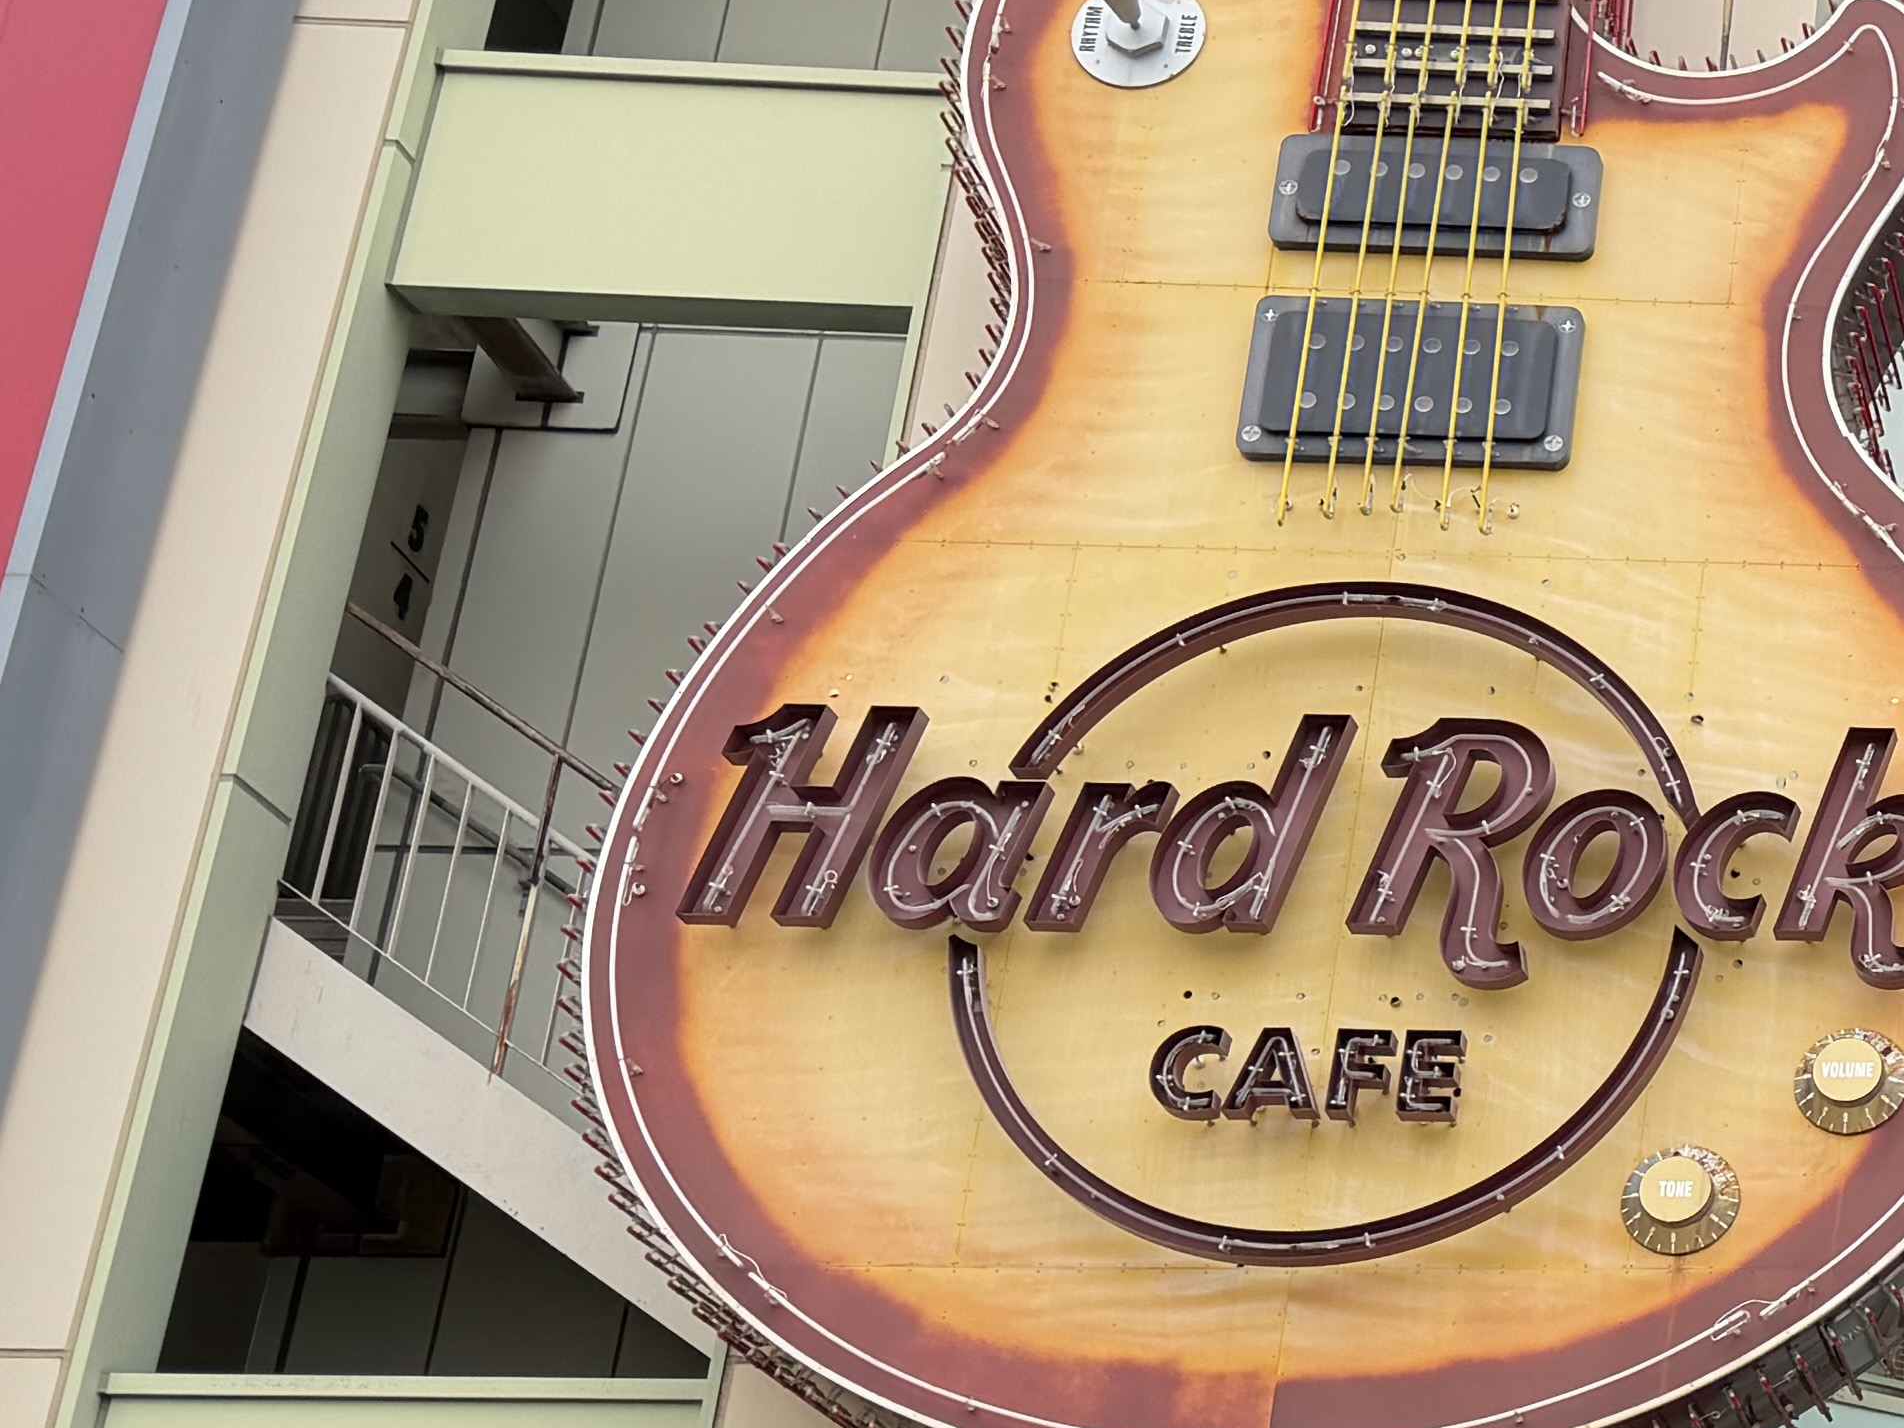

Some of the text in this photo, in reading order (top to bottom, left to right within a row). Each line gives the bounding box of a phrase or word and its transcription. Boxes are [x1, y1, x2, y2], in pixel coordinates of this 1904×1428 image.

[1079, 6, 1104, 53] RHYTHM
[1174, 14, 1198, 54] TREBLE
[407, 503, 429, 553] 5
[675, 703, 1356, 933] Hard
[1150, 1024, 1469, 1124] CAFE
[1820, 1060, 1875, 1079] VOLUME
[1659, 1180, 1694, 1198] TONE
